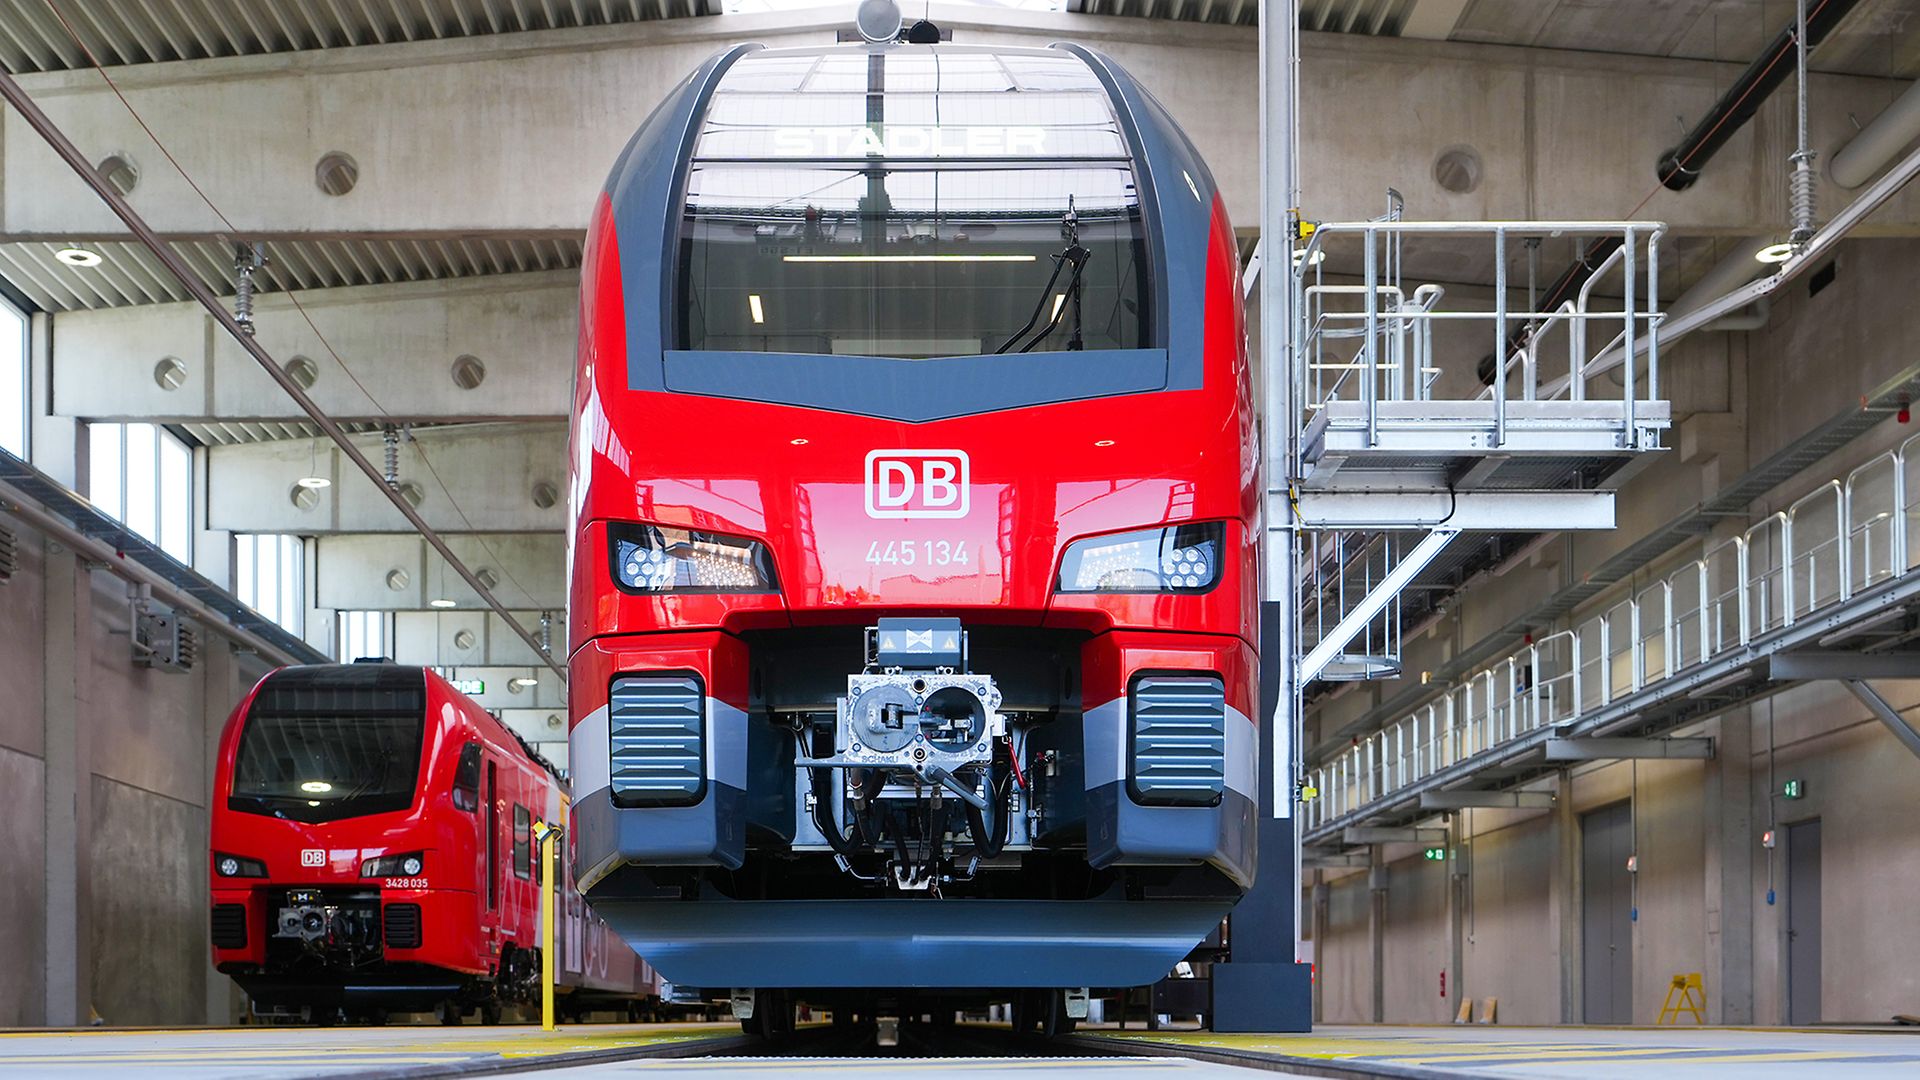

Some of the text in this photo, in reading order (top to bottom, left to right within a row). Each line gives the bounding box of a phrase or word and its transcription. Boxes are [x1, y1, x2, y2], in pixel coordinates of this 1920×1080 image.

[773, 126, 1047, 155] STADLER
[877, 459, 959, 508] DB
[865, 540, 969, 565] 445 134
[861, 755, 899, 763] SCHAKU
[303, 851, 324, 864] DB
[385, 878, 428, 888] 3428 035
